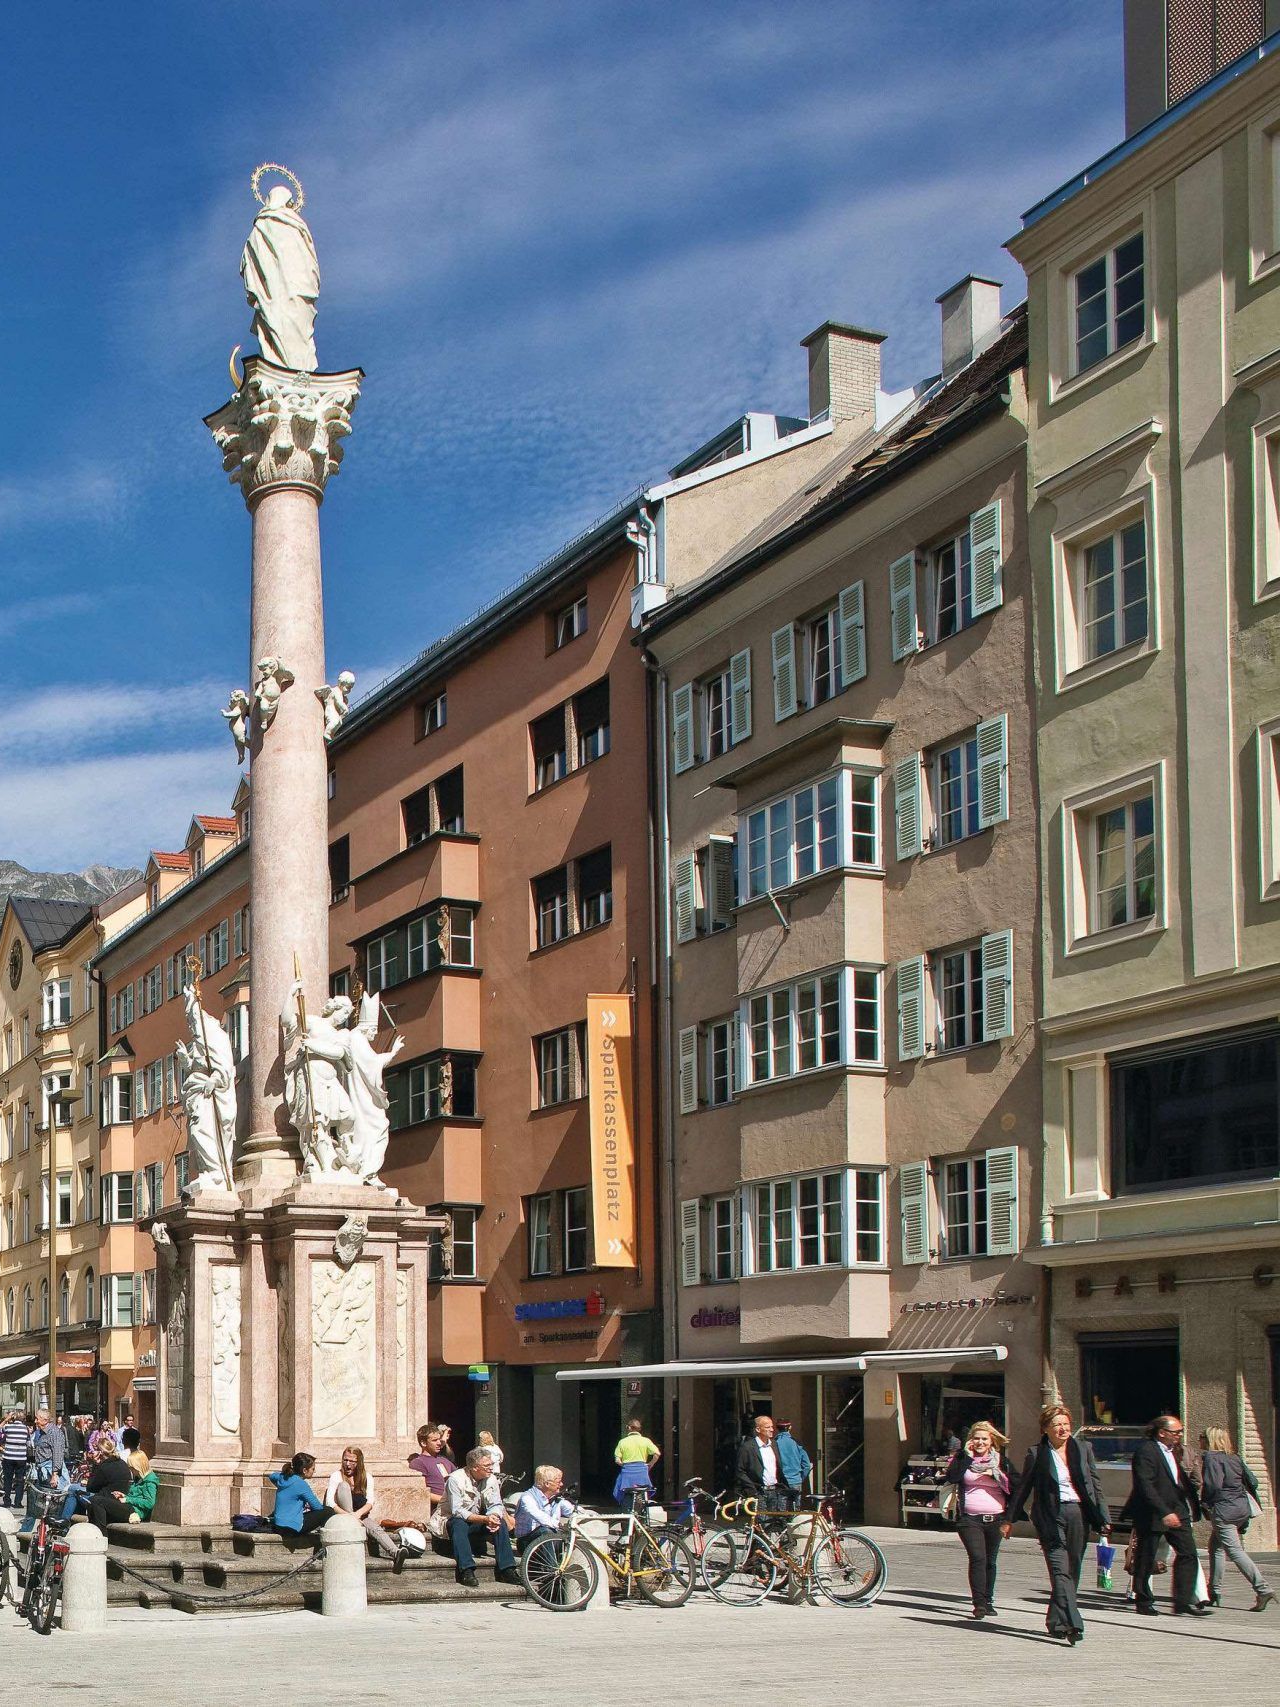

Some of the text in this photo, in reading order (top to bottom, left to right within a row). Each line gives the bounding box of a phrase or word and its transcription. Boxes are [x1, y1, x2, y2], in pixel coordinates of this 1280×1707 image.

[600, 1035, 621, 1221] sparkassenplatz
[1075, 1271, 1177, 1298] BAR
[900, 1295, 1030, 1314] accessories
[524, 1335, 535, 1343] am
